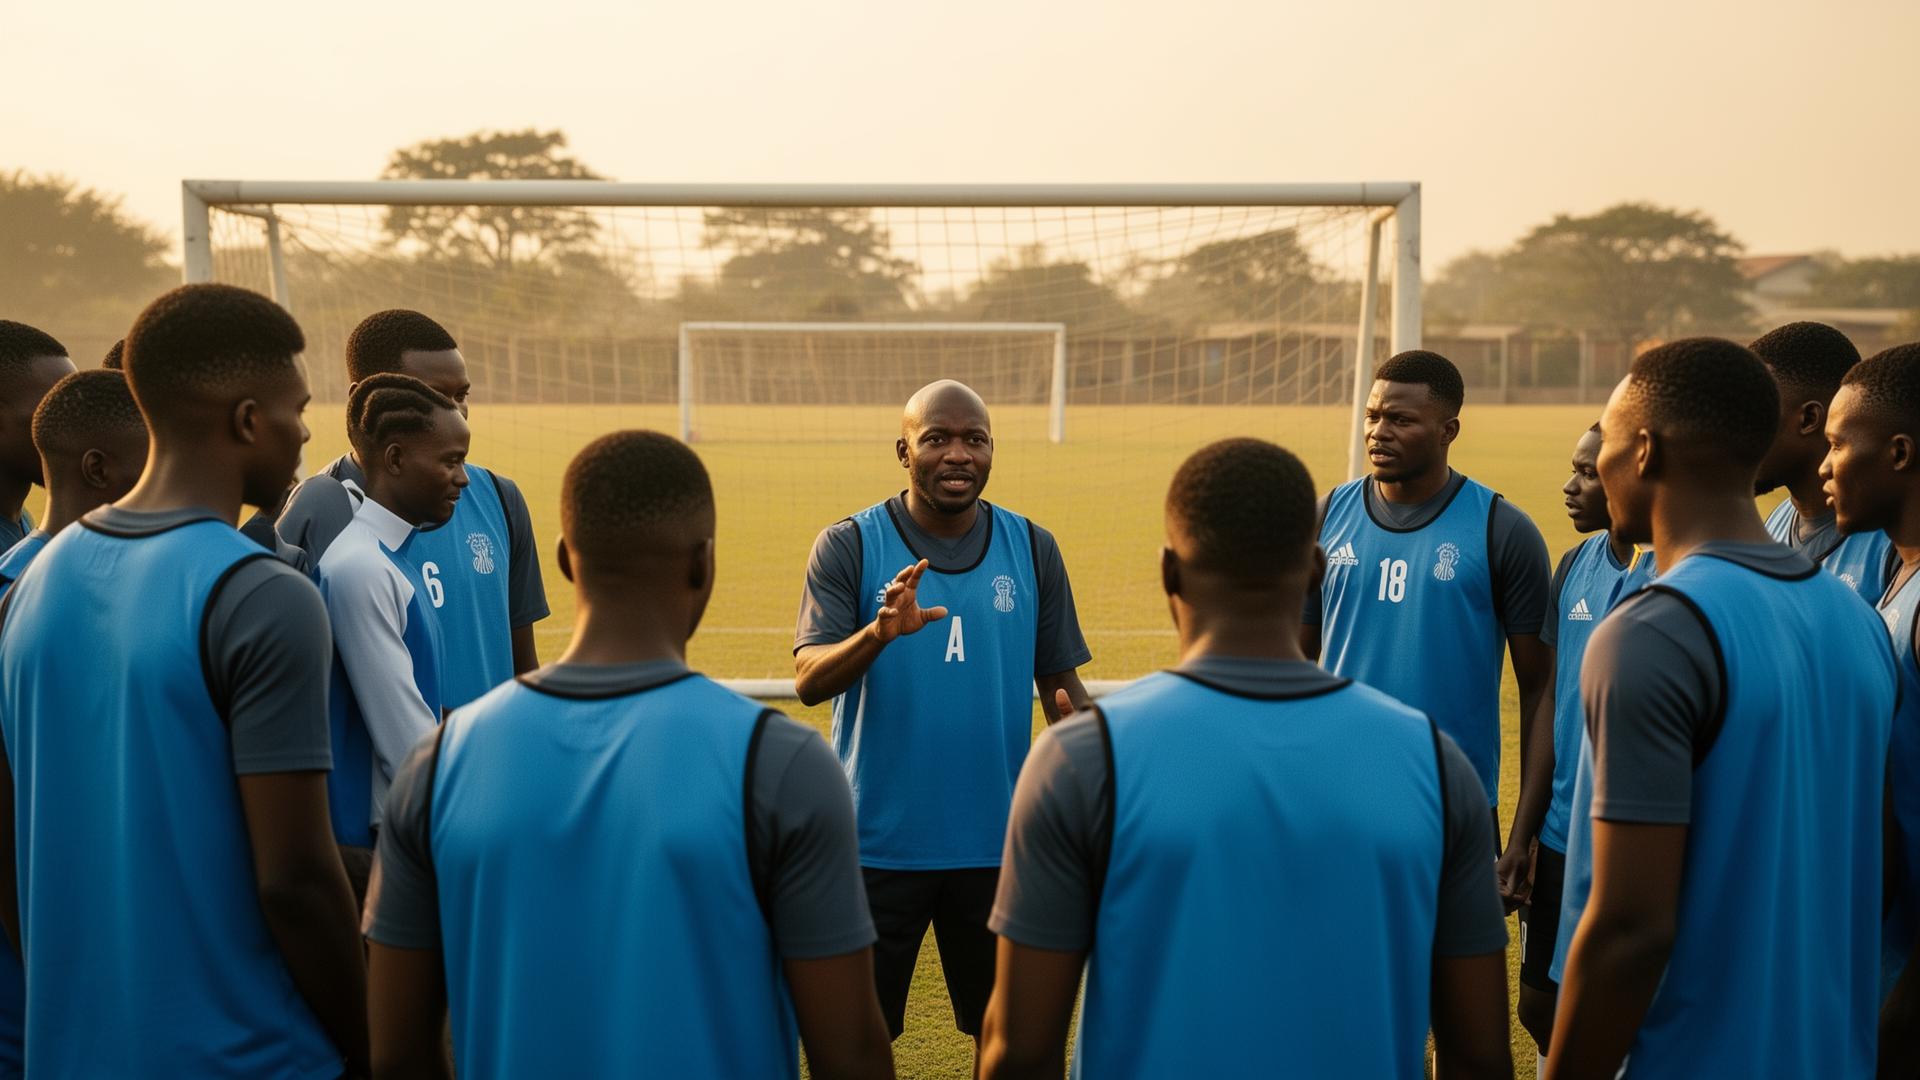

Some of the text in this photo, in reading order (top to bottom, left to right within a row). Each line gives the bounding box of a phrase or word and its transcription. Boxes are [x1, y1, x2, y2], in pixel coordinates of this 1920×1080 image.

[422, 561, 445, 608] 6
[1328, 556, 1359, 567] adidas
[1378, 557, 1408, 603] 18
[945, 616, 965, 662] A
